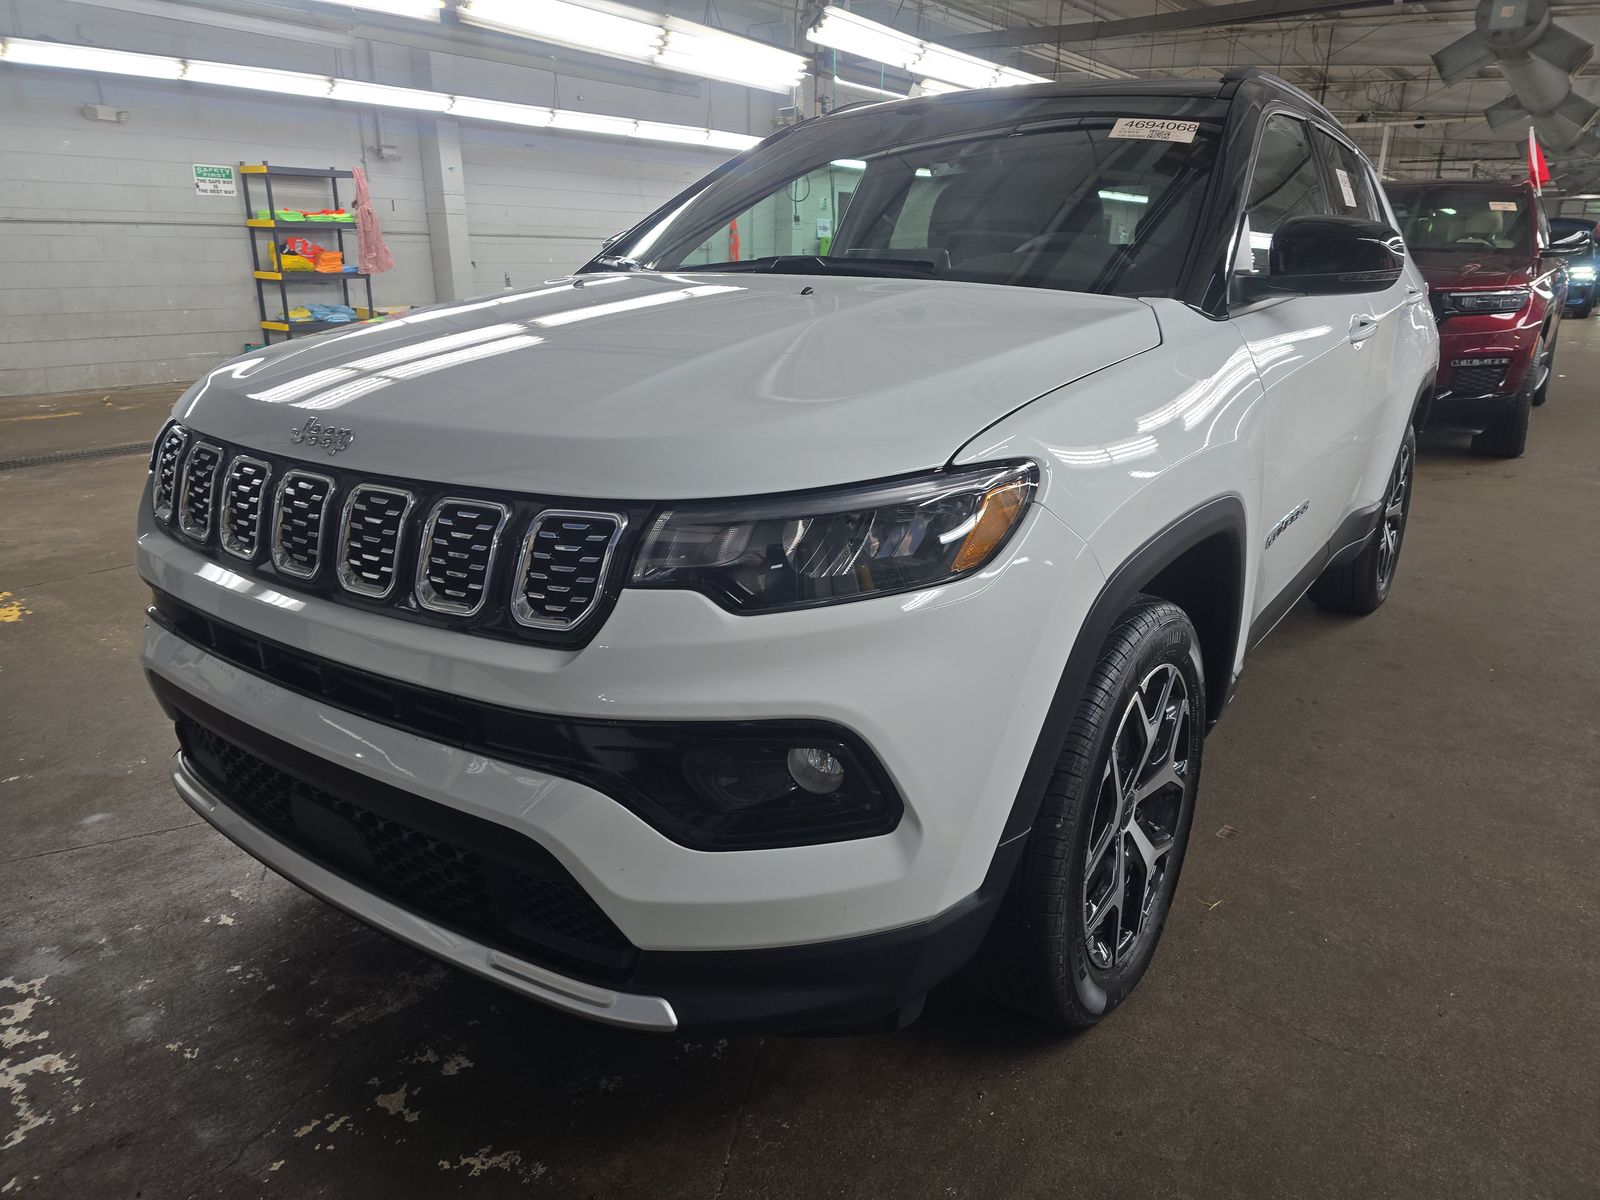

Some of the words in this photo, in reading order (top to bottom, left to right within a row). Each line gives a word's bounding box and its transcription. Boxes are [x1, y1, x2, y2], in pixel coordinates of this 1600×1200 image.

[1124, 120, 1198, 132] 4694068
[196, 166, 230, 174] SAFETY
[290, 416, 354, 456] Jeep
